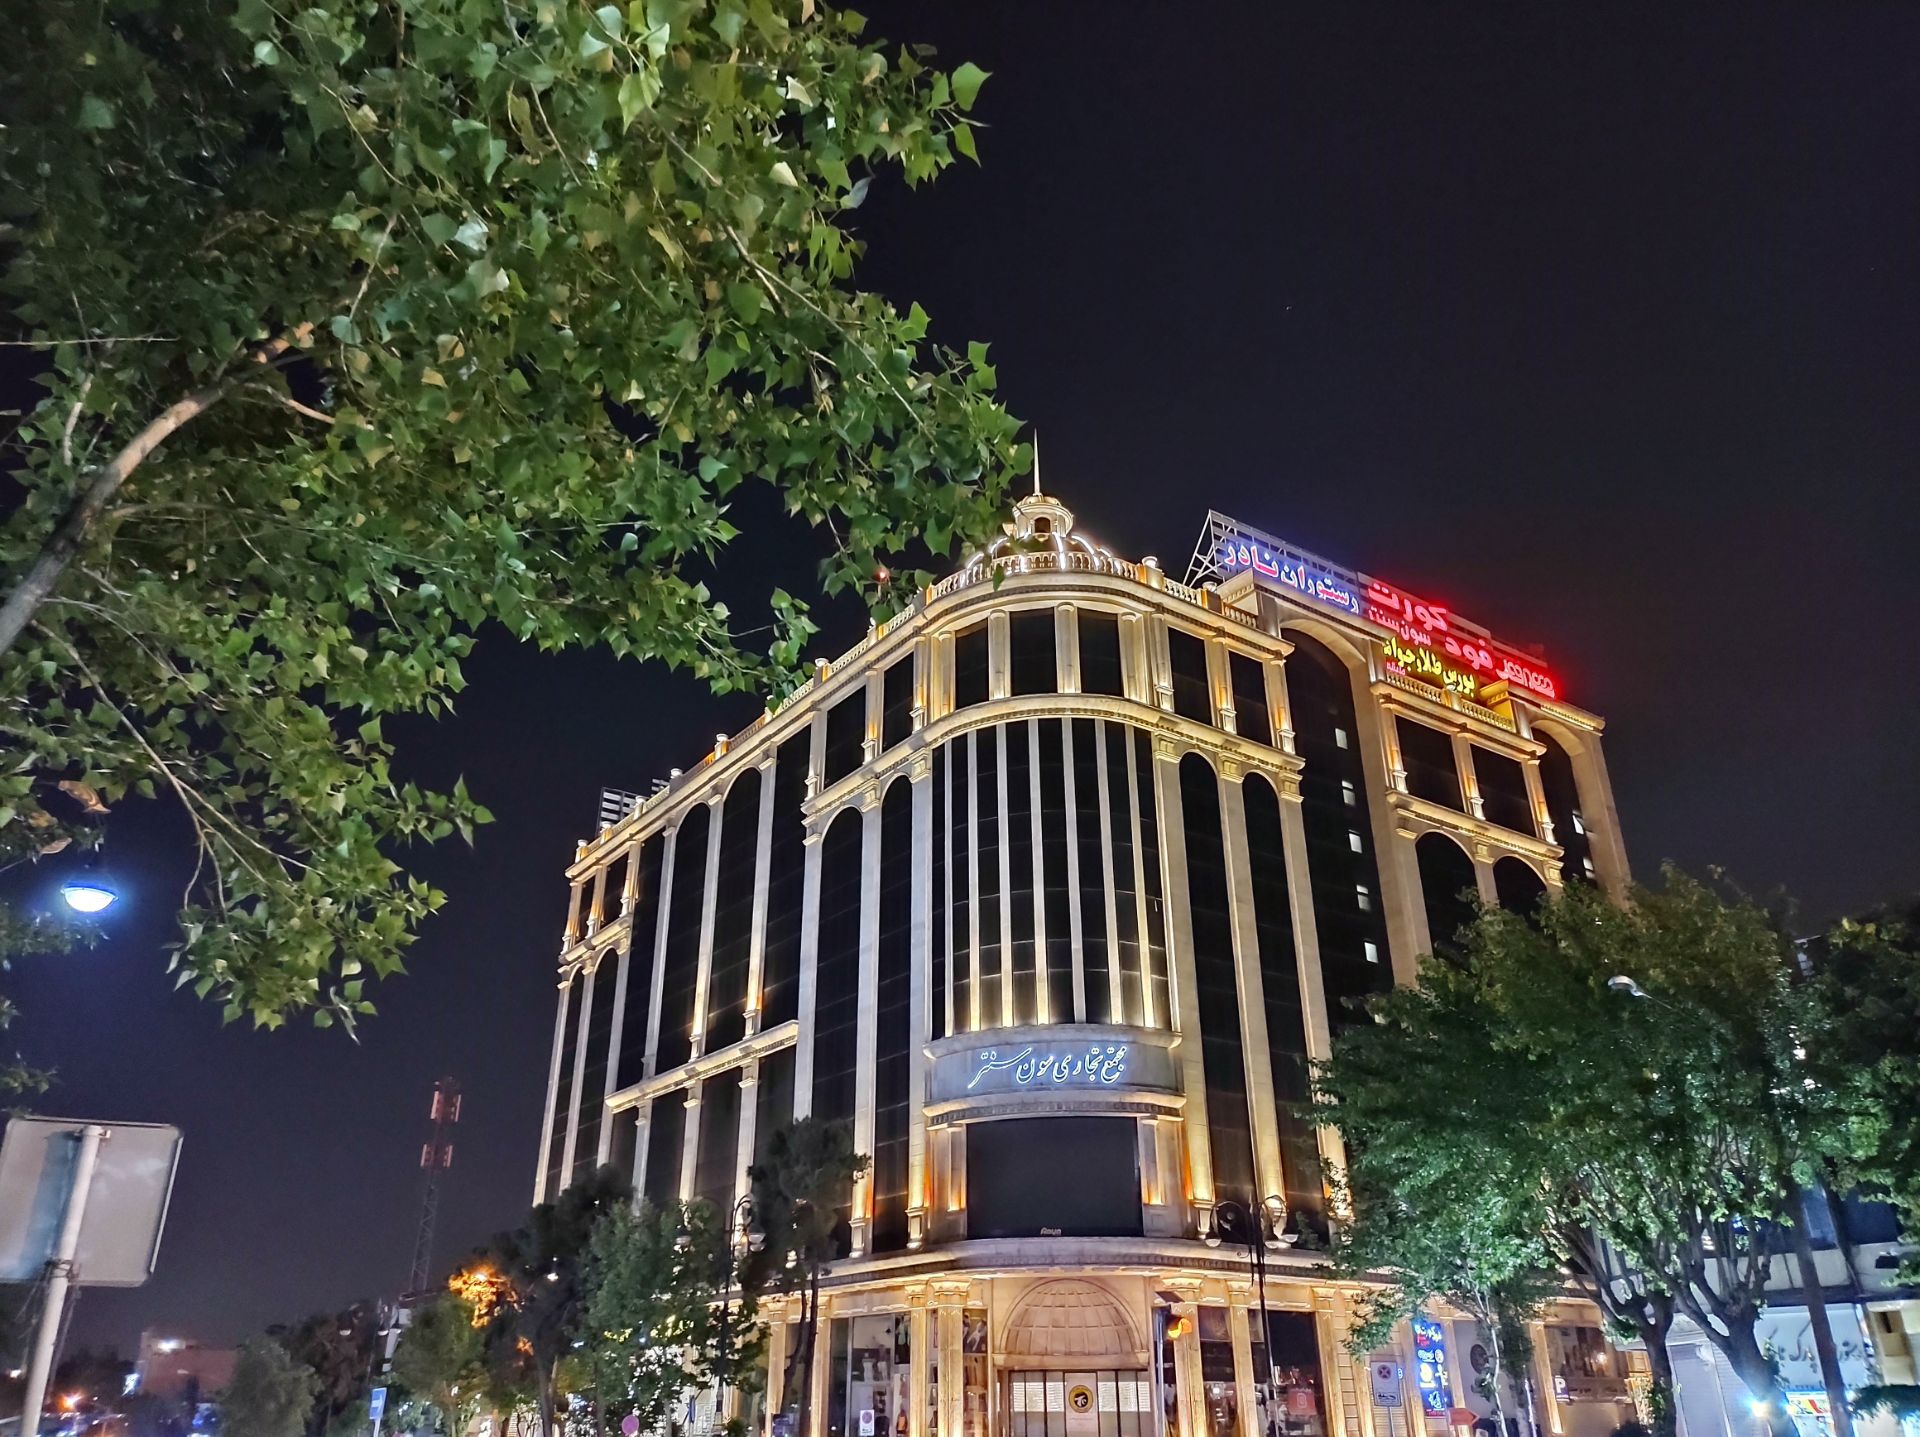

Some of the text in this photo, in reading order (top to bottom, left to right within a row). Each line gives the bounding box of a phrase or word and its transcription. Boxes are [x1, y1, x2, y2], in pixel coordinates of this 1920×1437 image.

[1224, 544, 1360, 615] رستوران نادر
[1368, 582, 1494, 671] فود کورت
[1399, 619, 1432, 647] سون
[1419, 646, 1442, 676] طلا
[1443, 670, 1475, 698] بورس
[968, 1045, 1128, 1089] مجتمع تجاری سون سنتر
[1554, 1378, 1566, 1394] P
